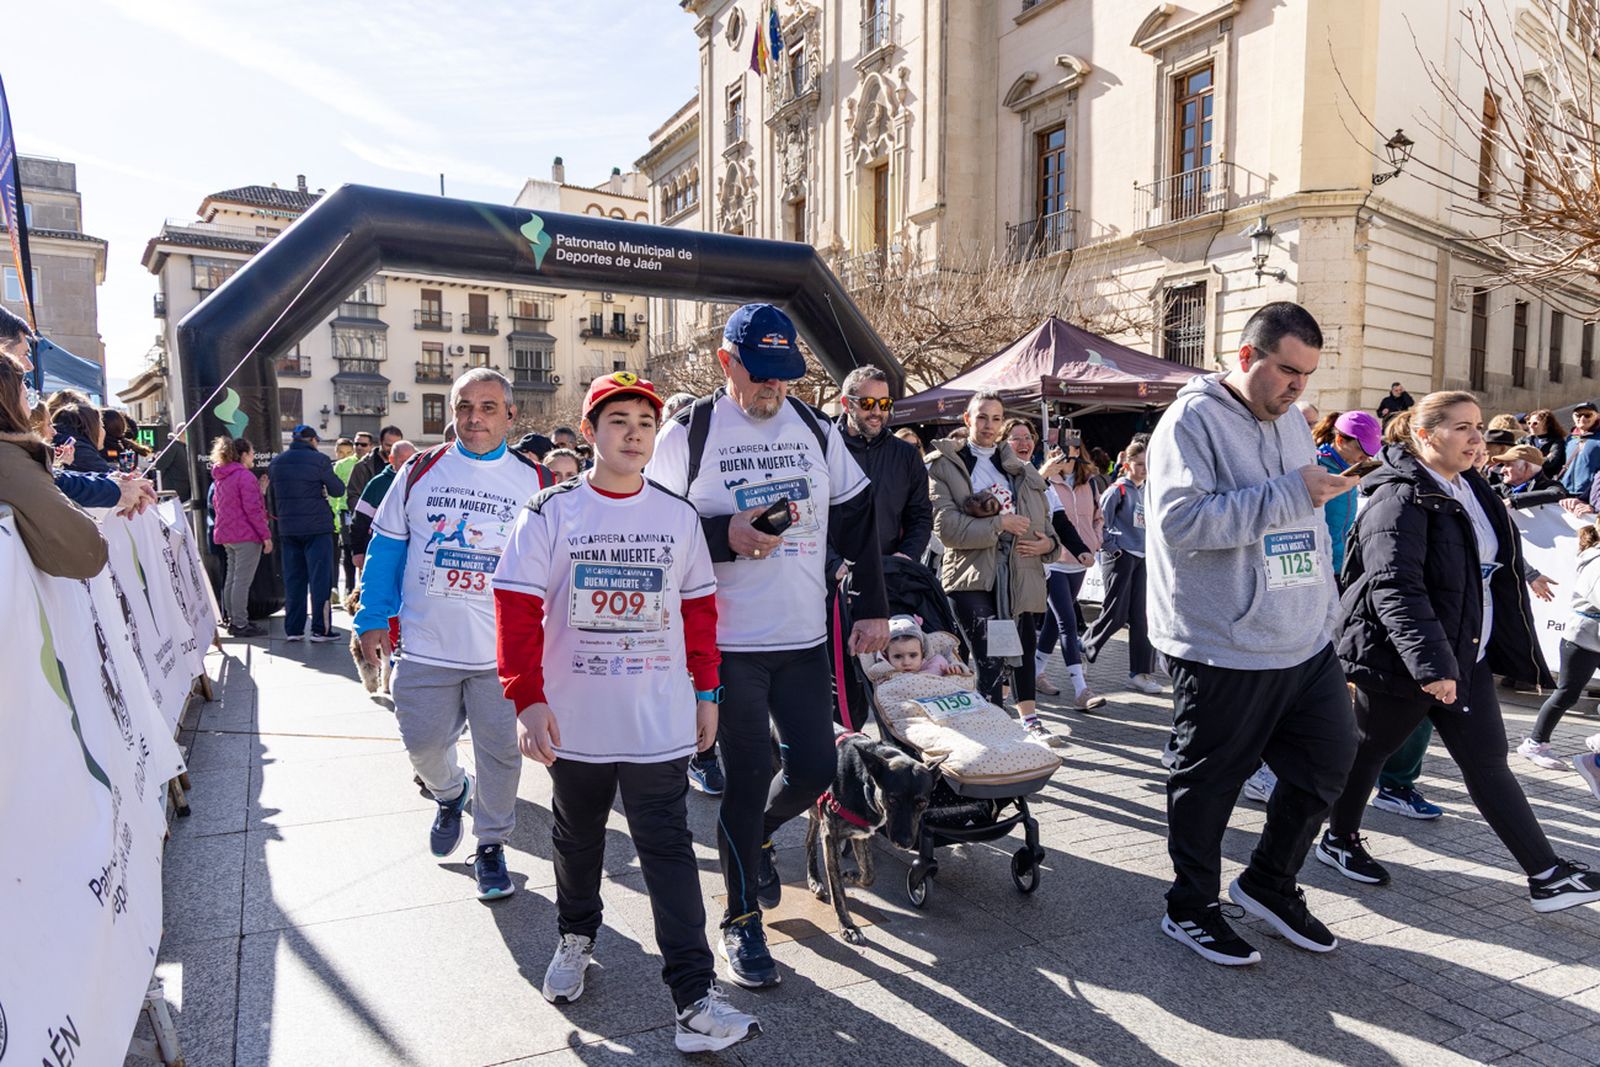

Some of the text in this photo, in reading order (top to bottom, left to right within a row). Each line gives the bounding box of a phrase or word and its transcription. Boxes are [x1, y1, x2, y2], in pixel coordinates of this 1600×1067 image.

[556, 234, 692, 260] Patronato Municipal de
[556, 248, 662, 271] Deportes de Jaén
[718, 442, 810, 456] VI CARRERA CAMINATA
[720, 455, 796, 473] BUENA MUERTE
[430, 486, 517, 506] VI CARRERA CAMINATA
[426, 496, 498, 516] BUENA MUERTE
[568, 534, 675, 546] VI CARRERA CAMINATA
[610, 548, 656, 563] MUERTE
[1279, 552, 1312, 575] 1125
[447, 569, 486, 591] 953
[623, 568, 654, 577] CAMINATA
[584, 577, 640, 590] BUENA MUERTE
[591, 590, 645, 616] 909
[933, 694, 972, 712] 1150
